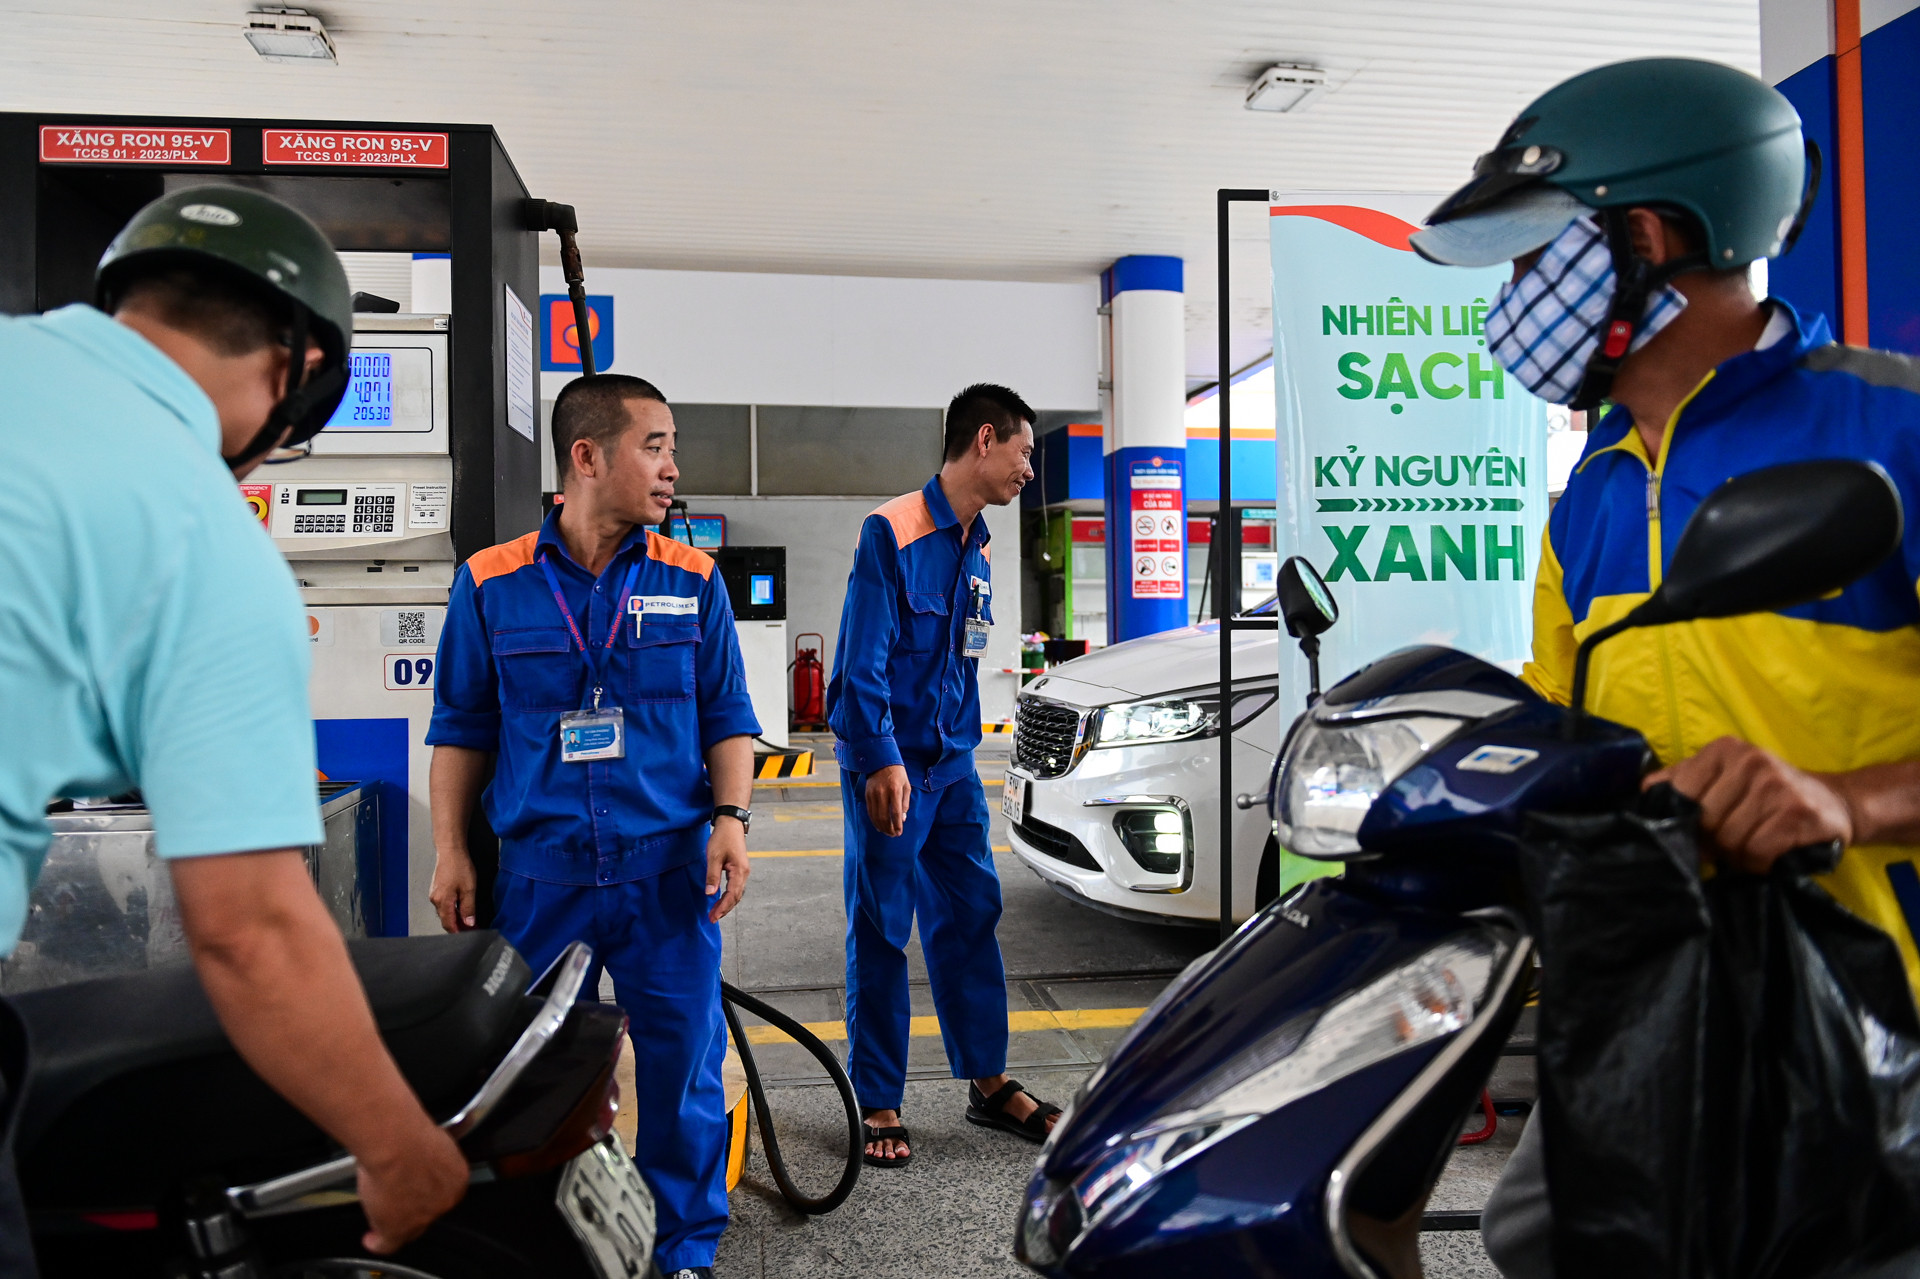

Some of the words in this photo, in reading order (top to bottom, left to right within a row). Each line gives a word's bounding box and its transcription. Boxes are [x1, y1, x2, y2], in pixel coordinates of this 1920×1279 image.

[56, 130, 115, 146] XĂNG
[121, 134, 165, 147] RON
[171, 135, 214, 148] 95-V
[279, 134, 336, 150] XĂNG
[342, 136, 384, 150] RON
[390, 138, 432, 152] 95-V
[73, 148, 110, 159] TCCS
[112, 149, 128, 159] 01
[139, 150, 198, 160] 2023/PLX
[295, 151, 330, 162] TCCS
[334, 152, 348, 162] 01
[360, 152, 416, 163] 2023/PLX
[1322, 297, 1432, 336] NHIÊN
[1442, 297, 1489, 346] LIỆ
[1336, 352, 1505, 415] SẠCH
[354, 406, 390, 420] 20530
[1314, 445, 1366, 488] KỶ
[1375, 447, 1526, 488] NGUYÊN
[356, 496, 362, 504] 7
[367, 496, 372, 504] 8
[377, 496, 382, 504] 9
[1321, 524, 1525, 582] XANH
[605, 612, 623, 648] Petrolimex
[394, 658, 433, 685] 09
[482, 946, 514, 996] HONDA
